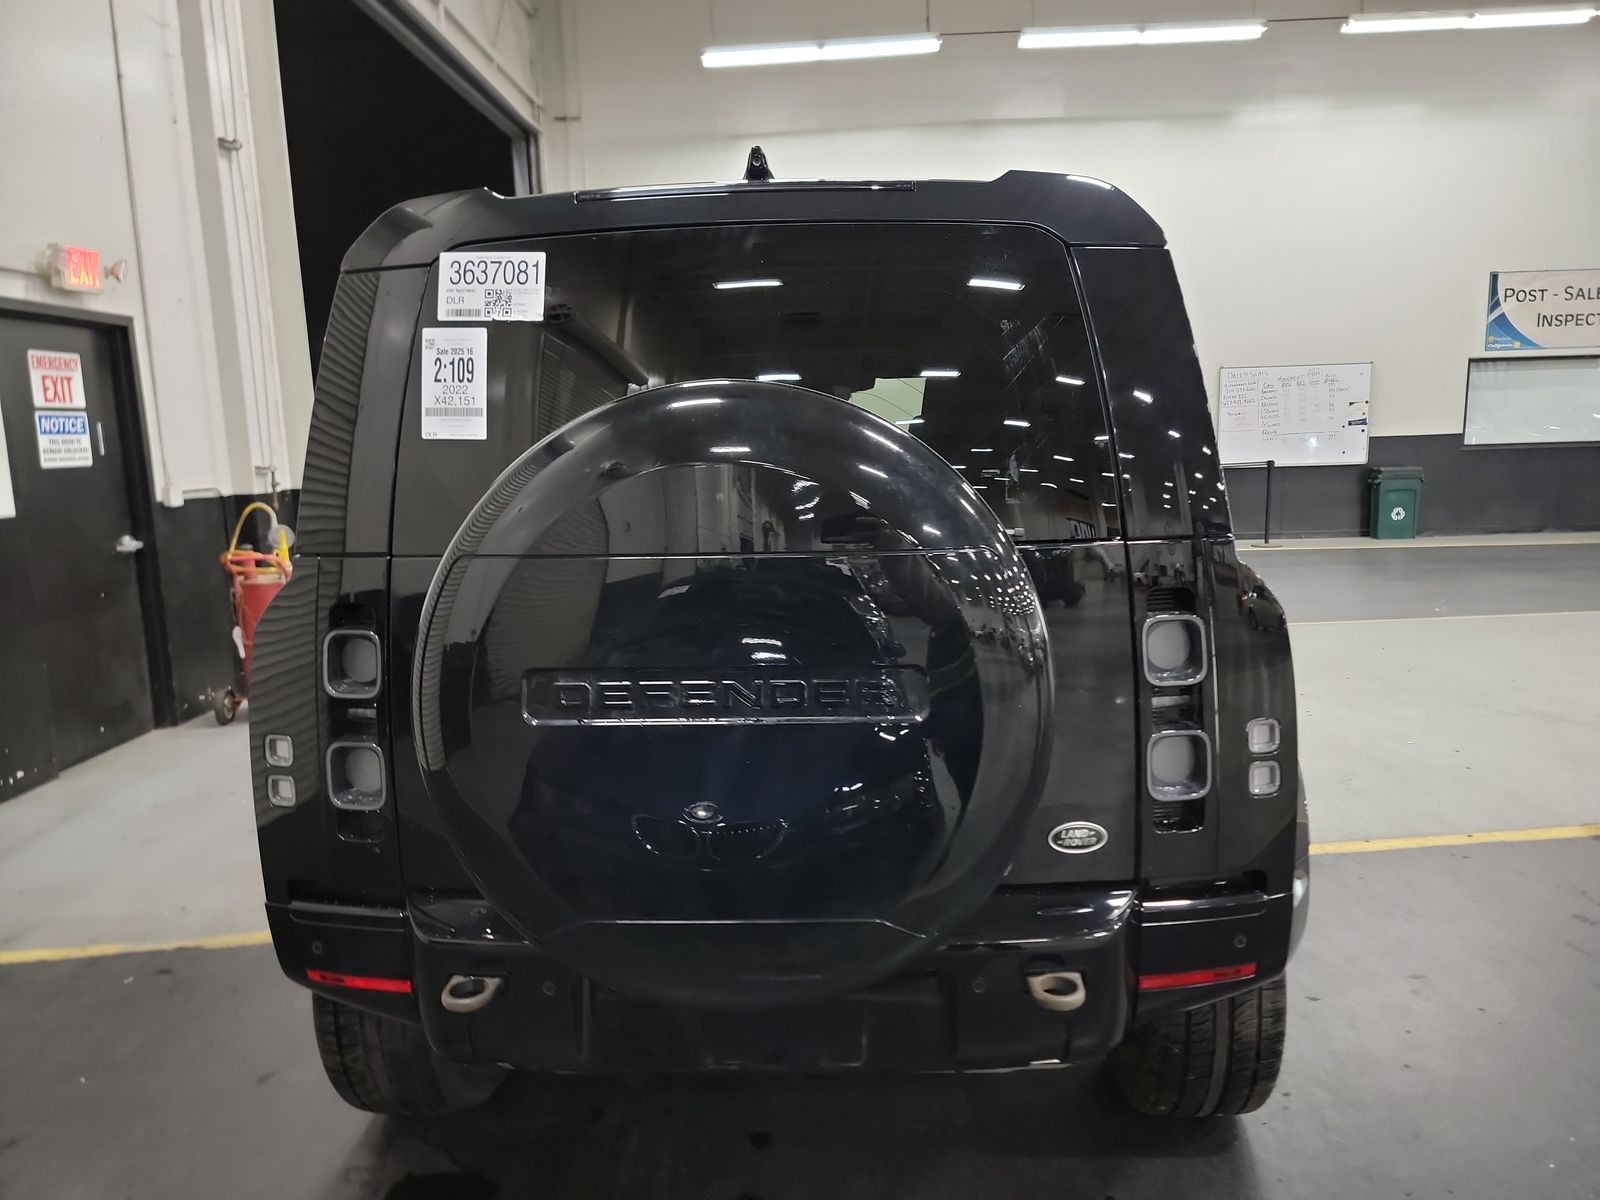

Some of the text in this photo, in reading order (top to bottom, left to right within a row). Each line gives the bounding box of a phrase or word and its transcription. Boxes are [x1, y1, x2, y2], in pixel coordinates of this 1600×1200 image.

[449, 260, 540, 286] 3637081
[446, 296, 465, 304] DLR
[1503, 287, 1548, 303] POST
[436, 347, 449, 356] Sale
[450, 347, 465, 356] 2025
[31, 354, 80, 373] EMERGENCY
[433, 357, 475, 384] 2:109
[40, 374, 74, 404] EXIT
[442, 384, 469, 395] 2022
[434, 395, 476, 407] X42,151
[40, 415, 86, 434] NOTICE
[552, 679, 900, 709] DEFENDER
[1061, 829, 1089, 838] LAND
[1063, 837, 1097, 846] ROVER
